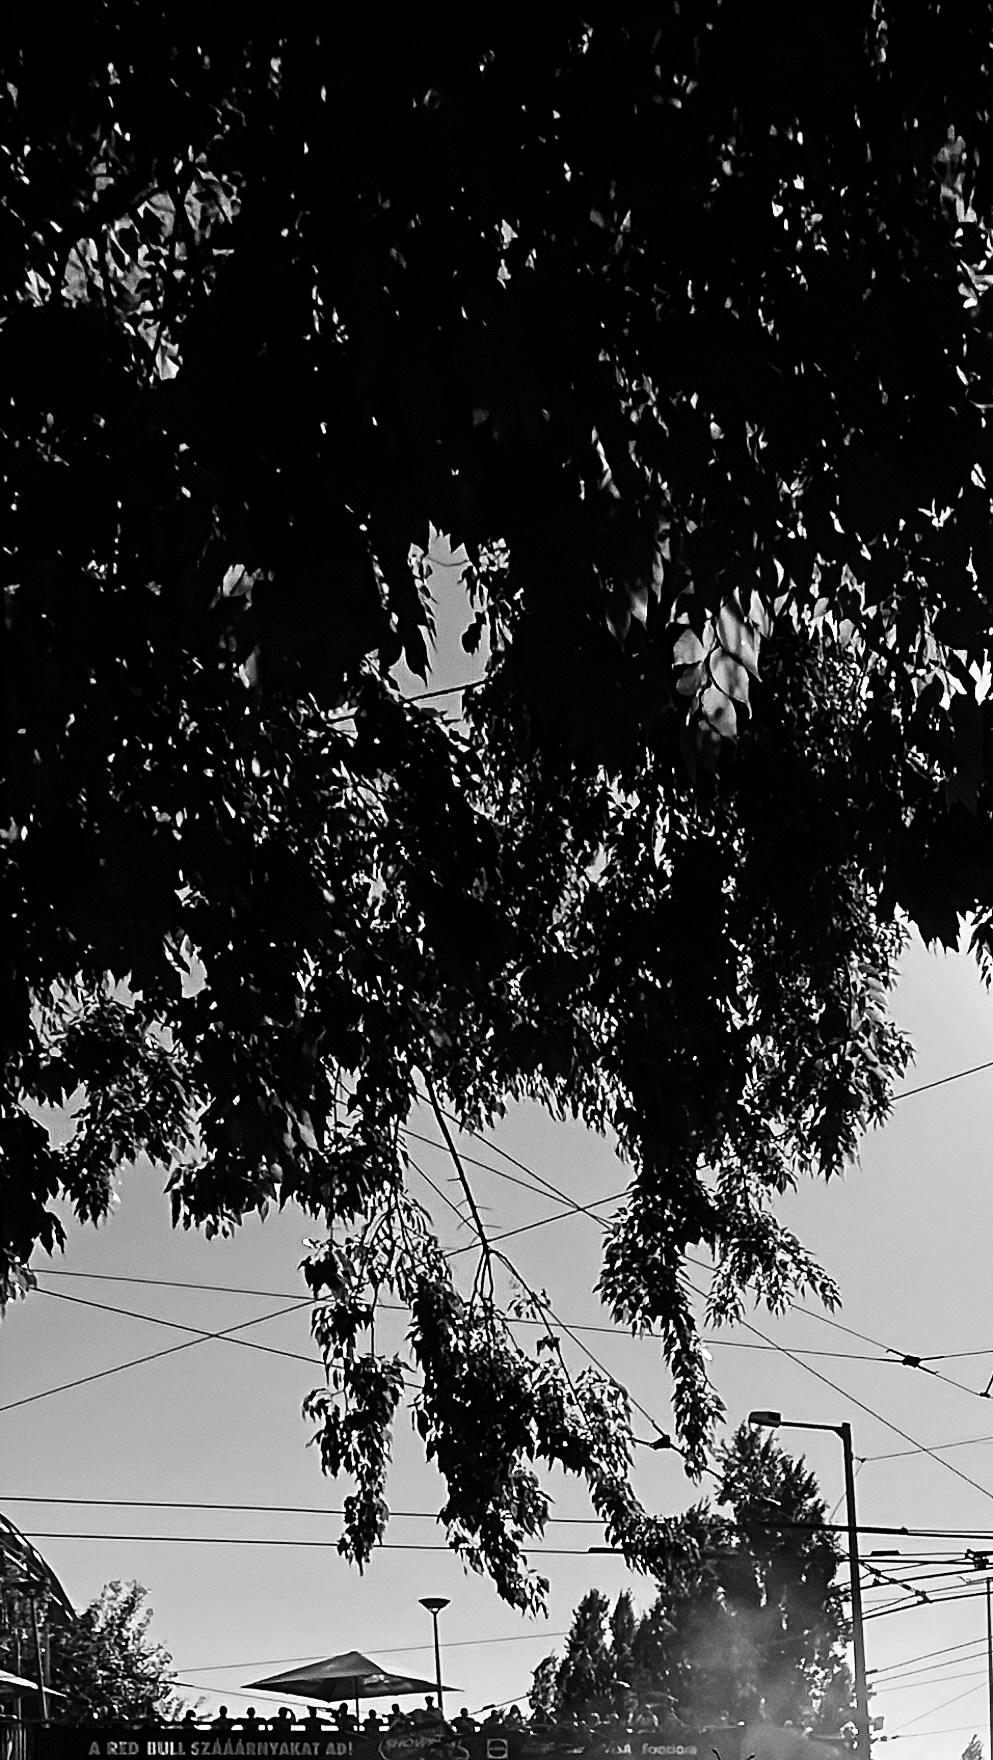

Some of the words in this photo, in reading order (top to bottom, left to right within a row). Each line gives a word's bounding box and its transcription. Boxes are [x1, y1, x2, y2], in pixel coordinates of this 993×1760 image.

[88, 1741, 100, 1756] A
[107, 1741, 139, 1756] RED
[147, 1741, 185, 1756] BULL
[190, 1738, 320, 1756] SZÁÁÁRNYAKAT
[325, 1741, 353, 1756] AD!
